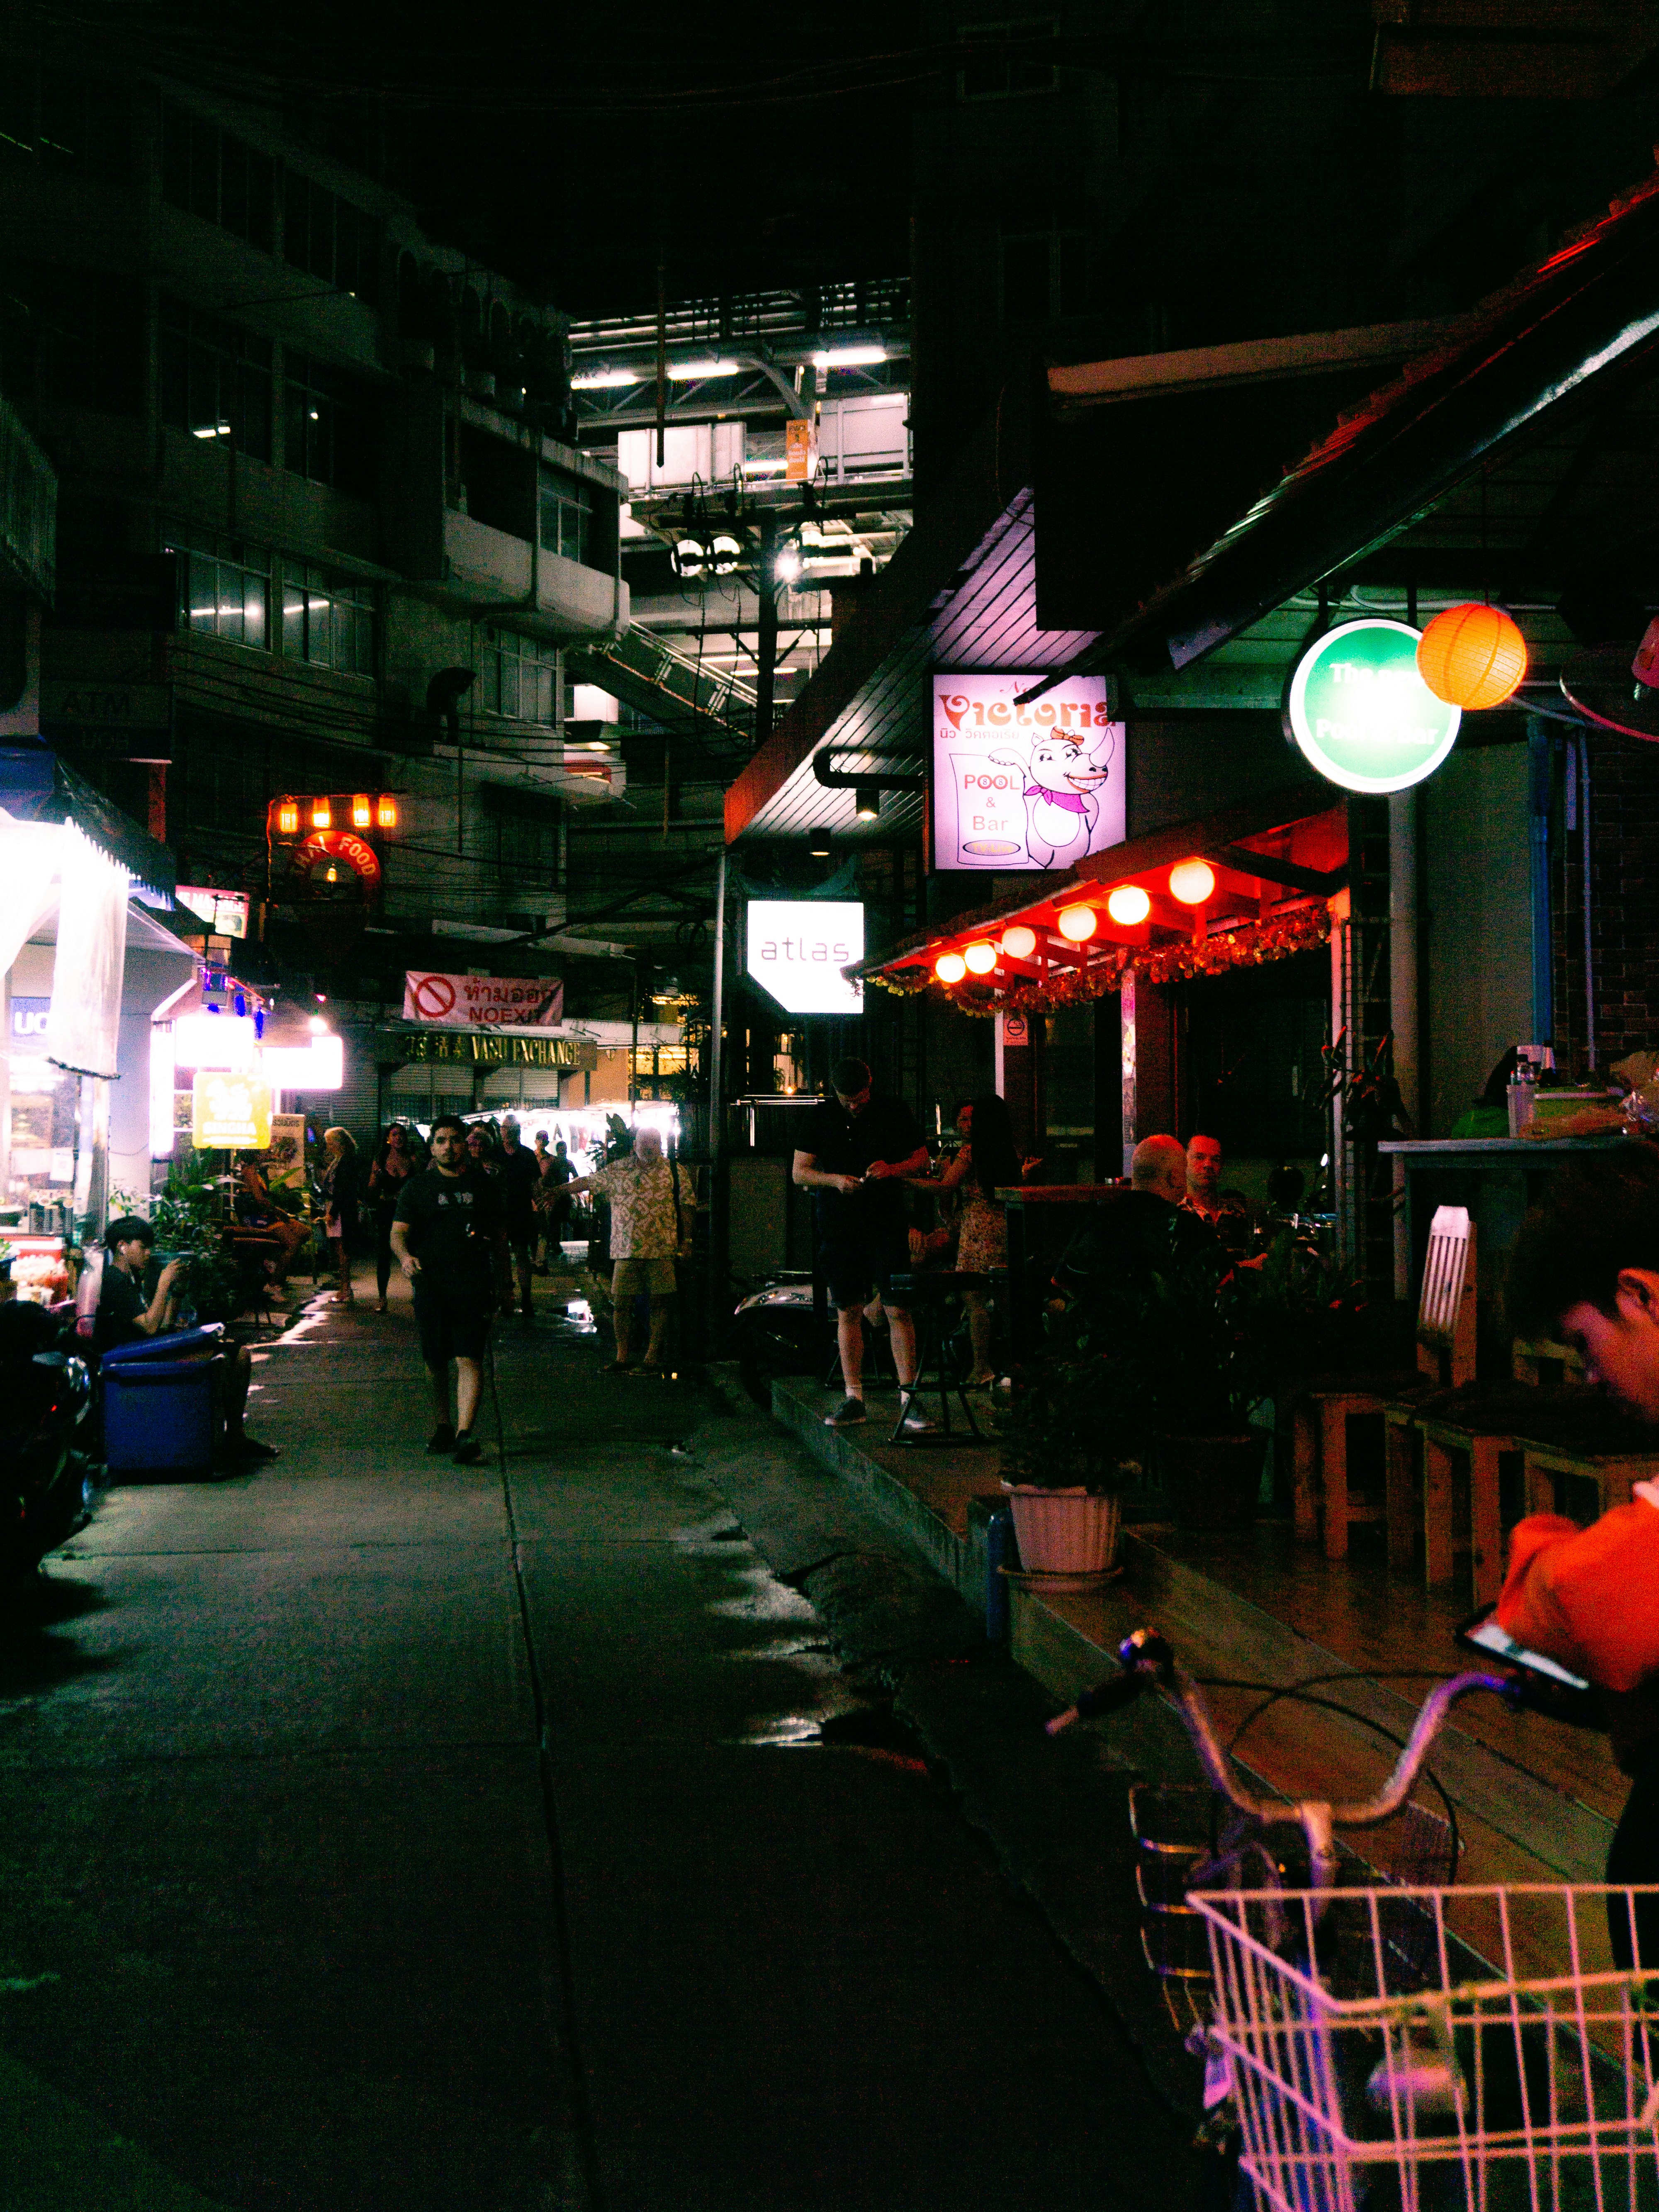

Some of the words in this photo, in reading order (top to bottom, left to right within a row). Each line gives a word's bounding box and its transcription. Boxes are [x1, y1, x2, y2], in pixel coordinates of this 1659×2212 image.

[1330, 663, 1373, 684] The
[62, 691, 130, 714] ATM
[936, 694, 1117, 731] Victoria
[1316, 718, 1366, 741] Pool
[1397, 724, 1439, 745] Bar
[964, 774, 1020, 790] POOL
[985, 797, 996, 808] &
[973, 815, 1009, 831] Bar
[338, 837, 376, 876] FOOD
[761, 937, 849, 962] atlas
[14, 1011, 50, 1035] UO
[513, 1038, 581, 1065] EXCHANGE
[203, 1121, 256, 1134] SINGHA
